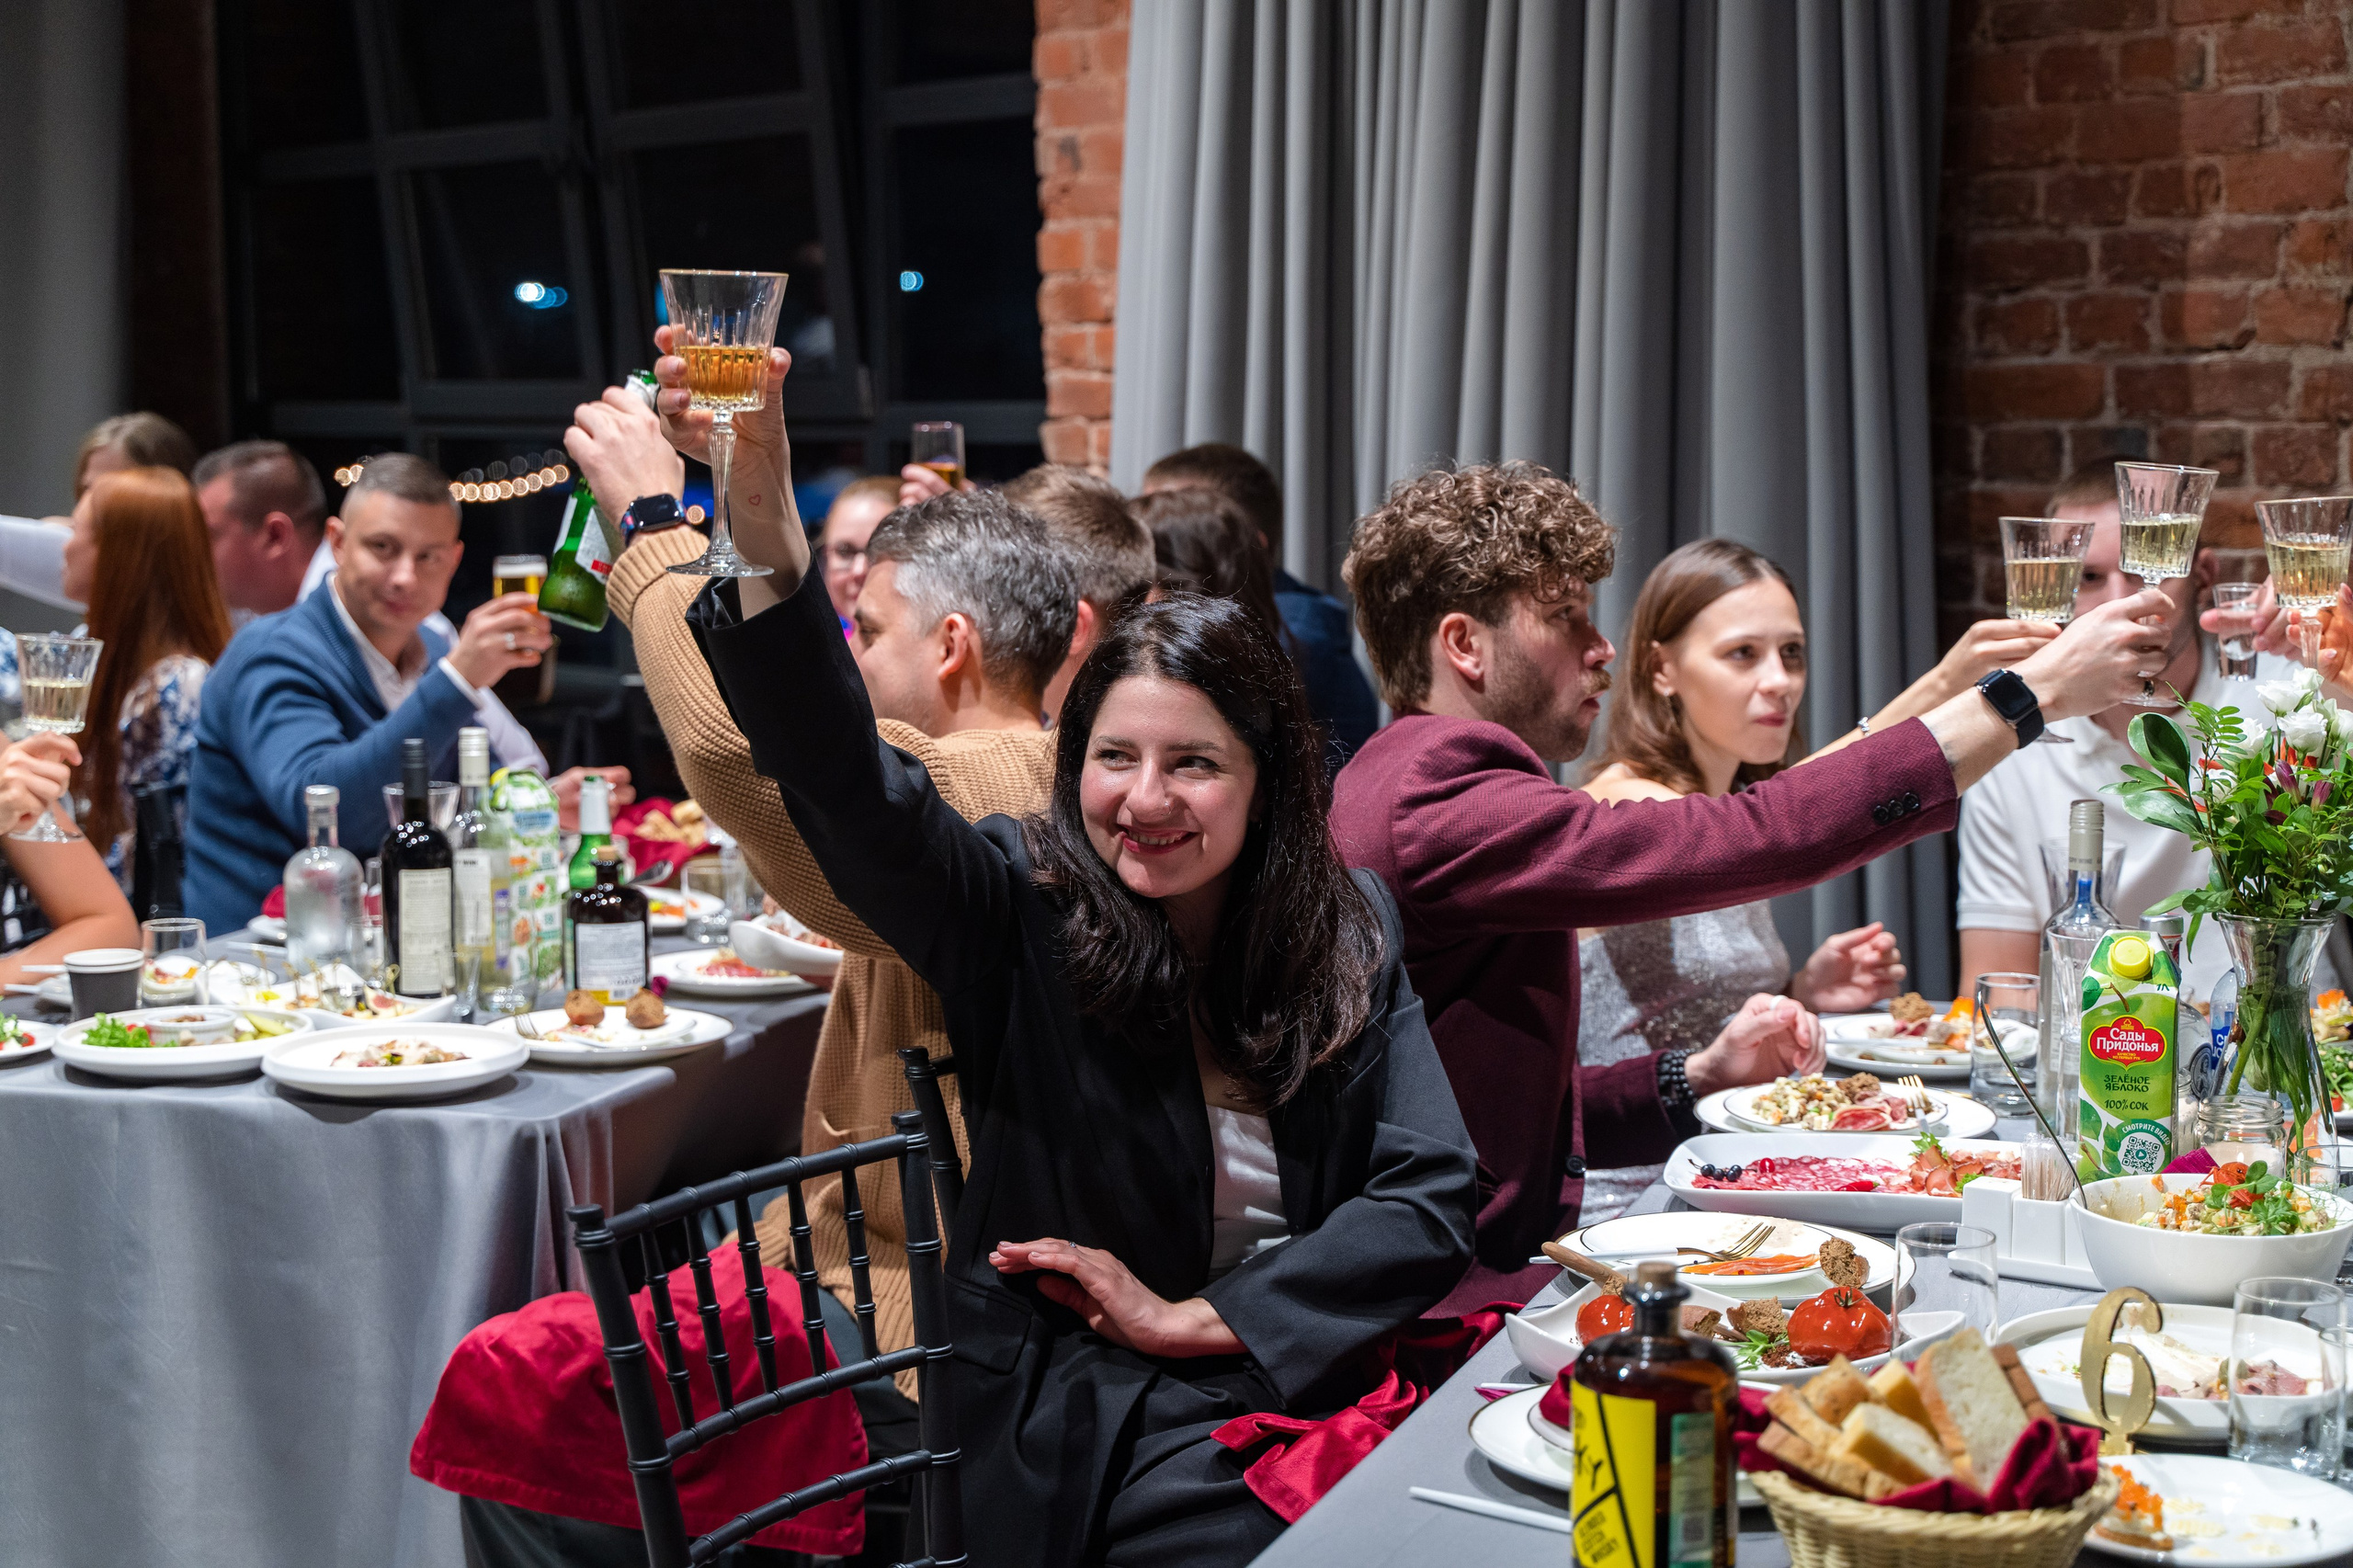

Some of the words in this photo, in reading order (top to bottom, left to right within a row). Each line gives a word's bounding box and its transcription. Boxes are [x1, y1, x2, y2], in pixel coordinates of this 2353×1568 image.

[2109, 1027, 2145, 1042] Сады
[2097, 1037, 2159, 1052] Придонья
[2103, 1074, 2151, 1085] ЗЕЛЁНОЕ
[2105, 1083, 2149, 1093] ЯБЛОКО
[2105, 1098, 2129, 1110] 100%
[2129, 1101, 2149, 1110] СОК
[2121, 1122, 2155, 1133] СМОТРИТЕ
[2154, 1127, 2171, 1145] ВИДЕО
[2080, 1286, 2164, 1437] 6
